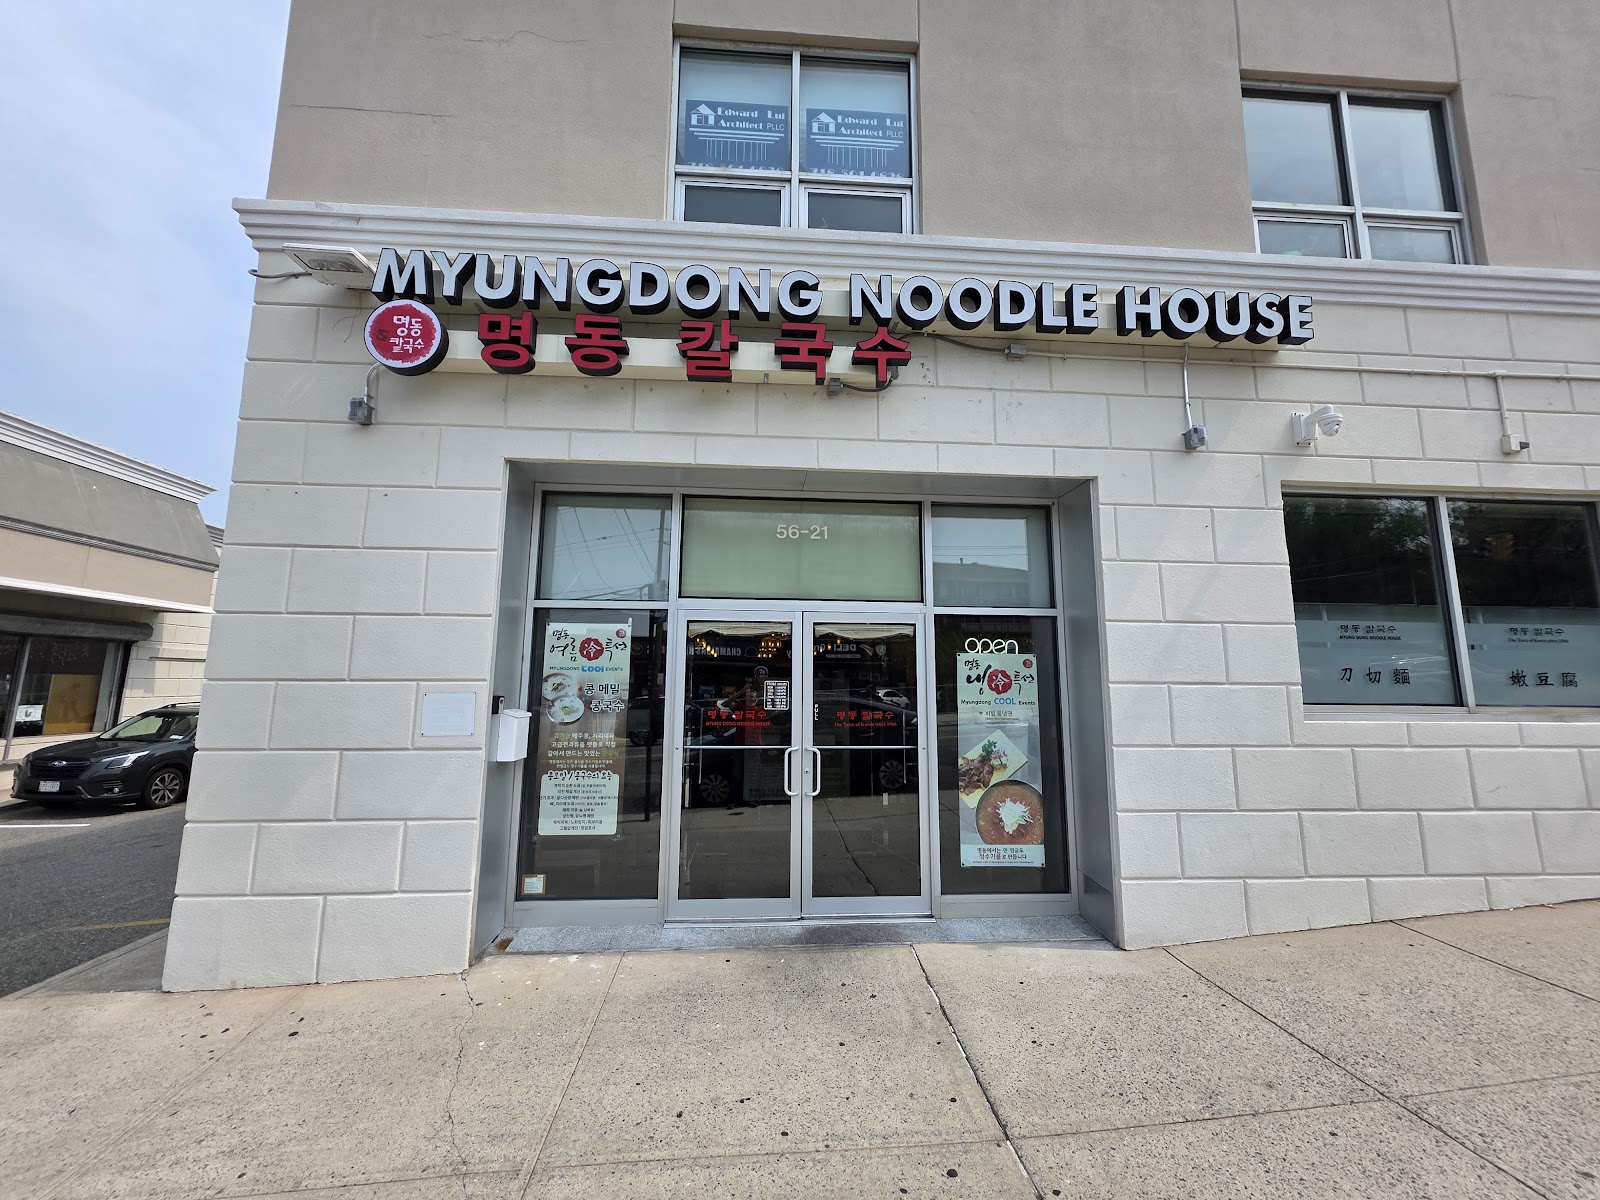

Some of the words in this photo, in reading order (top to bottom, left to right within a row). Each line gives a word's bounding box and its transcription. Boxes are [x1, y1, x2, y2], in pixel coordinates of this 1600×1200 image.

[717, 107, 758, 118] Edward
[767, 110, 785, 120] Lui
[717, 119, 763, 130] Architect
[766, 122, 785, 131] PLLC
[837, 115, 878, 126] Edward
[886, 118, 904, 128] Lui
[838, 126, 883, 137] Architect
[886, 130, 904, 138] PLLC
[370, 247, 825, 321] MYUNGDONG
[849, 273, 1099, 332] NOODLE
[1118, 286, 1315, 343] HOUSE
[392, 315, 423, 337] 명동
[389, 337, 425, 354] 칼국수
[776, 524, 828, 540] 56-21
[1340, 624, 1361, 633] 명동
[1365, 625, 1397, 634] 칼국수
[1510, 627, 1529, 636] 명동
[1533, 627, 1565, 637] 칼국수
[965, 638, 1018, 654] open
[584, 683, 595, 695] 콩
[598, 683, 620, 695] 메밀
[590, 699, 625, 712] 콩국수
[994, 697, 1016, 705] COOL
[707, 710, 729, 720] 명동
[836, 711, 858, 720] 명동
